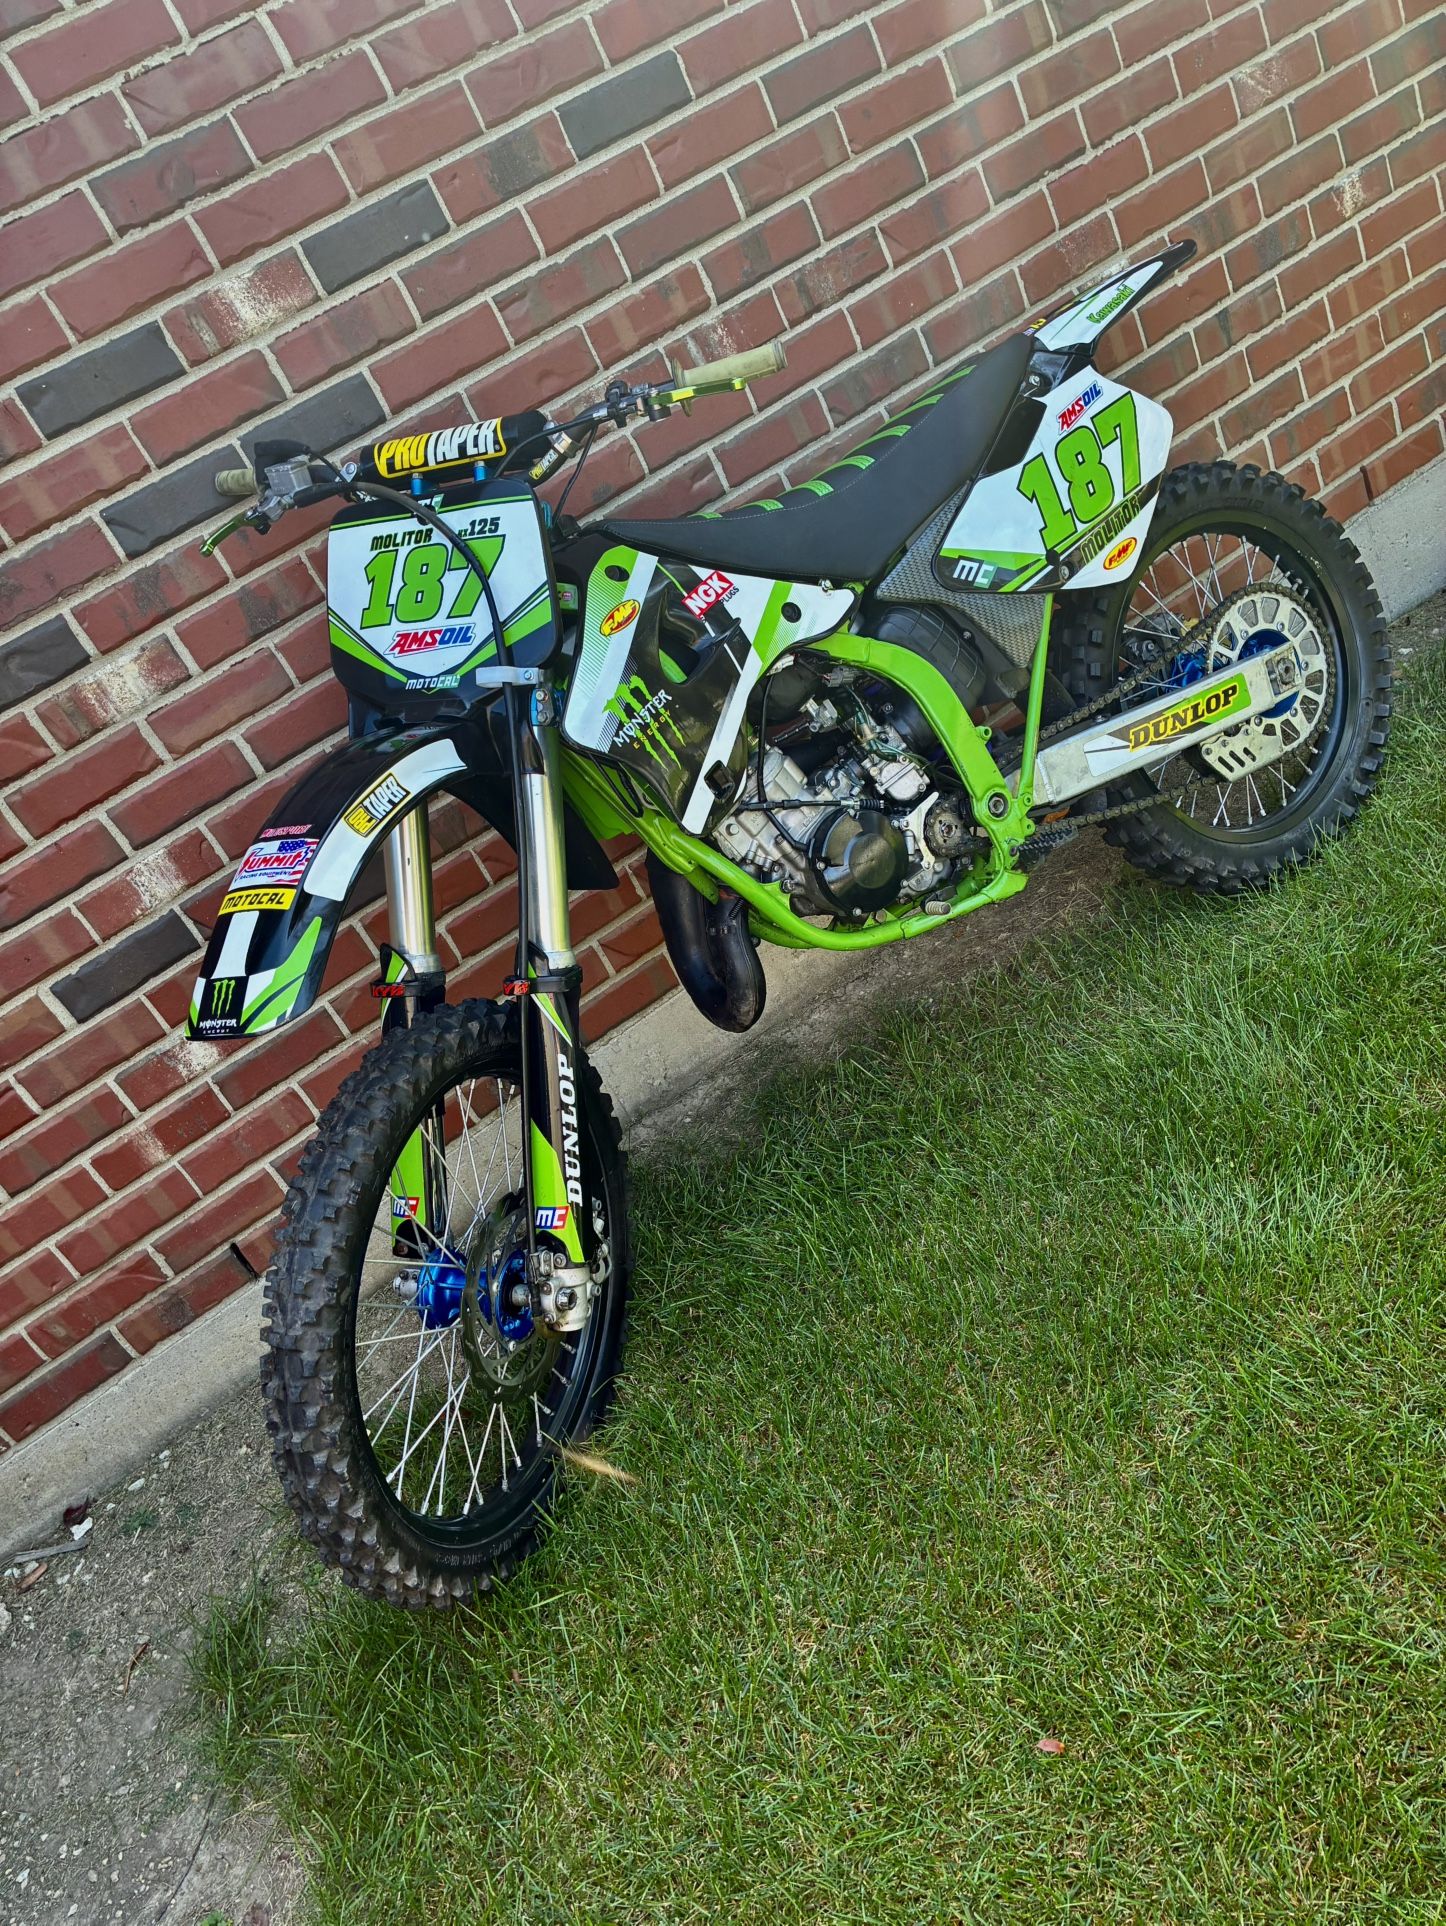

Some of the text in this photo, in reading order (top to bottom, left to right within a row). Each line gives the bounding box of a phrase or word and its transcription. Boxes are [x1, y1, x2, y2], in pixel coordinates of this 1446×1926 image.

[1086, 284, 1135, 324] Kawasaki
[1058, 383, 1101, 431] AMSOIL
[1017, 391, 1141, 551] 187
[370, 528, 433, 551] MOLITOR
[1081, 494, 1140, 565] MOLITOR
[360, 535, 505, 630] 187
[684, 572, 731, 616] NGK
[389, 626, 473, 654] AMSOIL
[602, 600, 637, 636] FMF
[406, 674, 460, 691] MOTOCAL
[613, 689, 672, 748] MONSTER
[633, 709, 671, 750] ENERGY
[1129, 683, 1239, 752] DUNLOP
[362, 775, 407, 819] TAPER
[223, 892, 286, 910] MOTOCAL
[199, 1018, 237, 1029] MONSTER
[558, 1054, 583, 1207] DUNLOP
